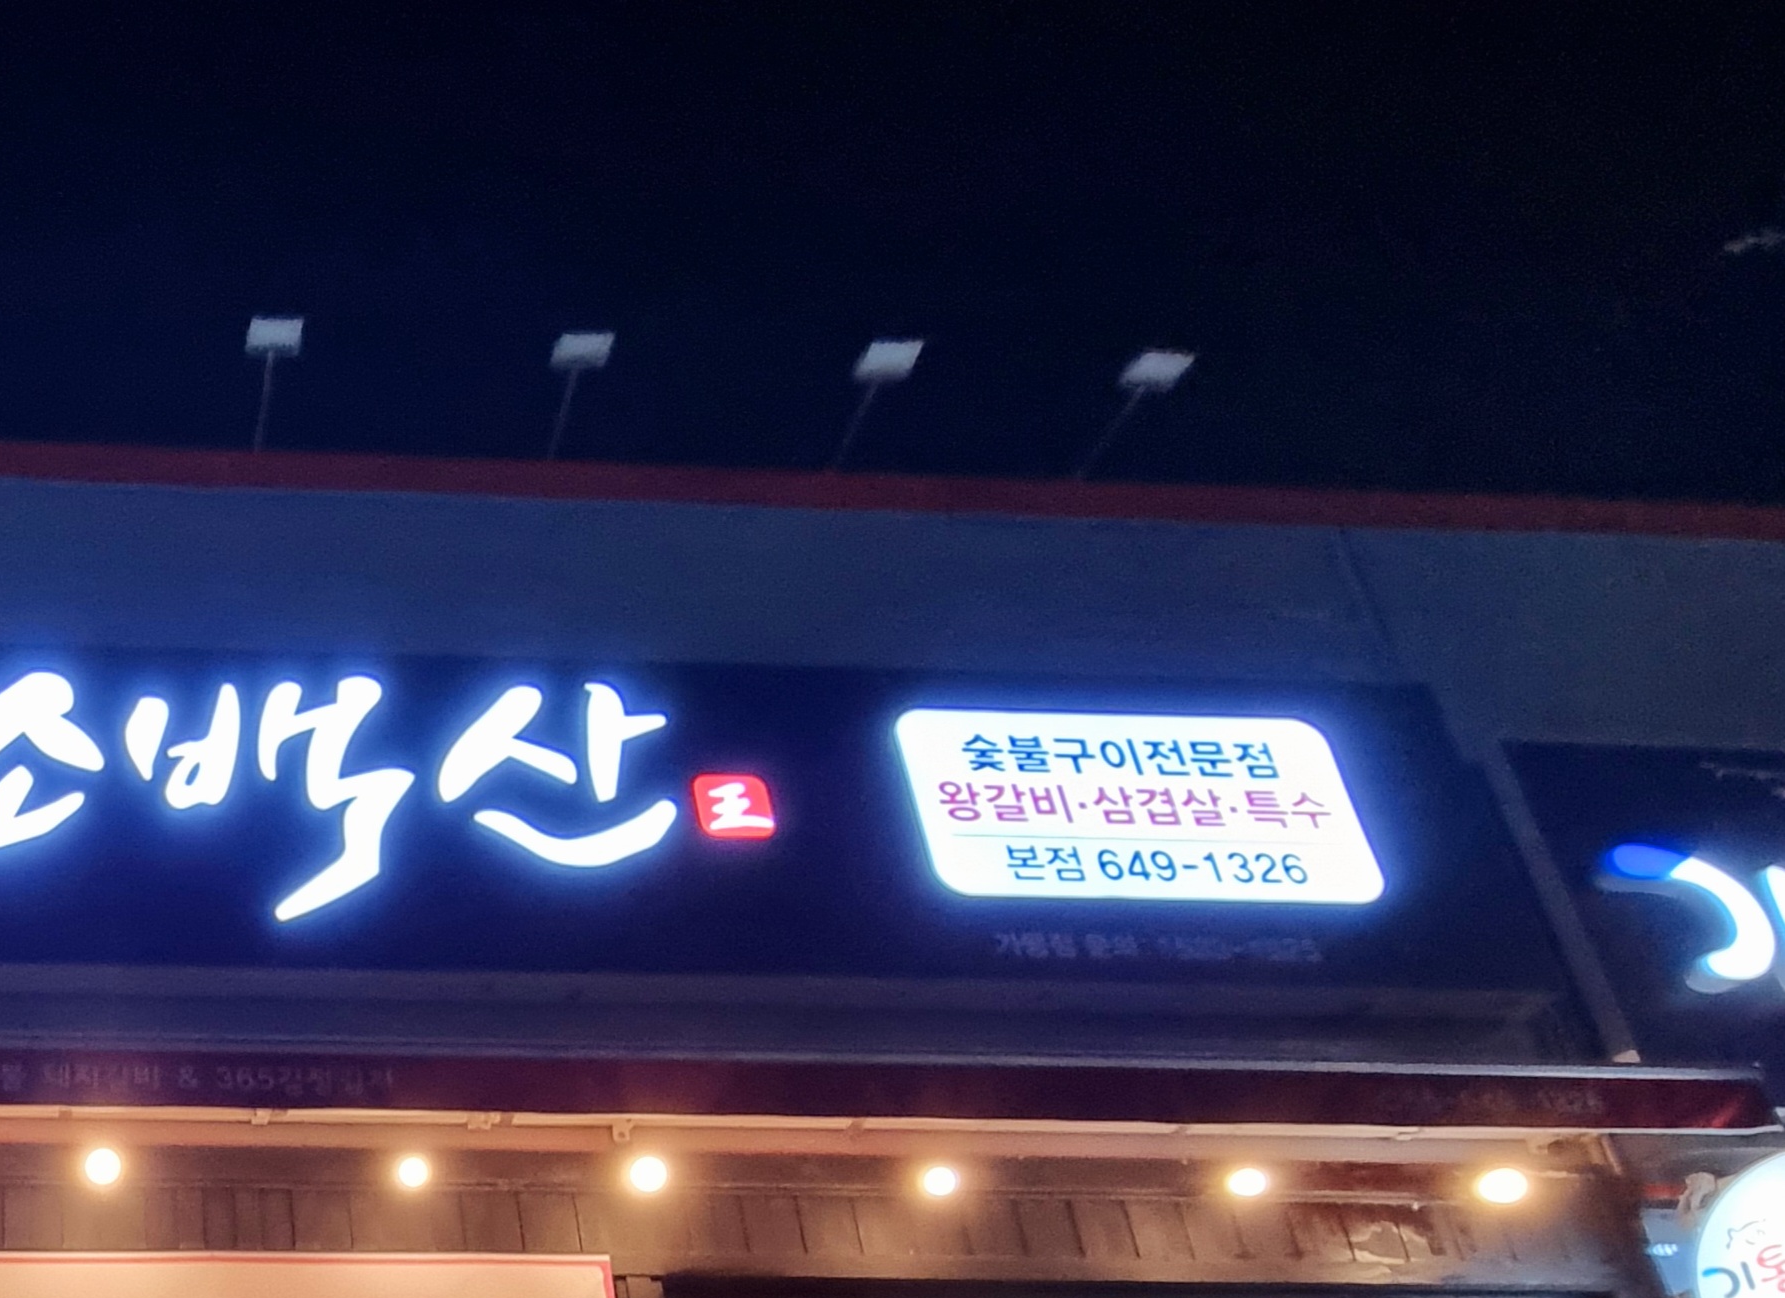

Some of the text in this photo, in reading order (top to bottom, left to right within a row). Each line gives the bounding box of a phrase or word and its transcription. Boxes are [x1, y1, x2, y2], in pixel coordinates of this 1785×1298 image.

[961, 733, 1281, 779] 숯불구이전문점
[1006, 844, 1309, 885] 본점 649-1326
